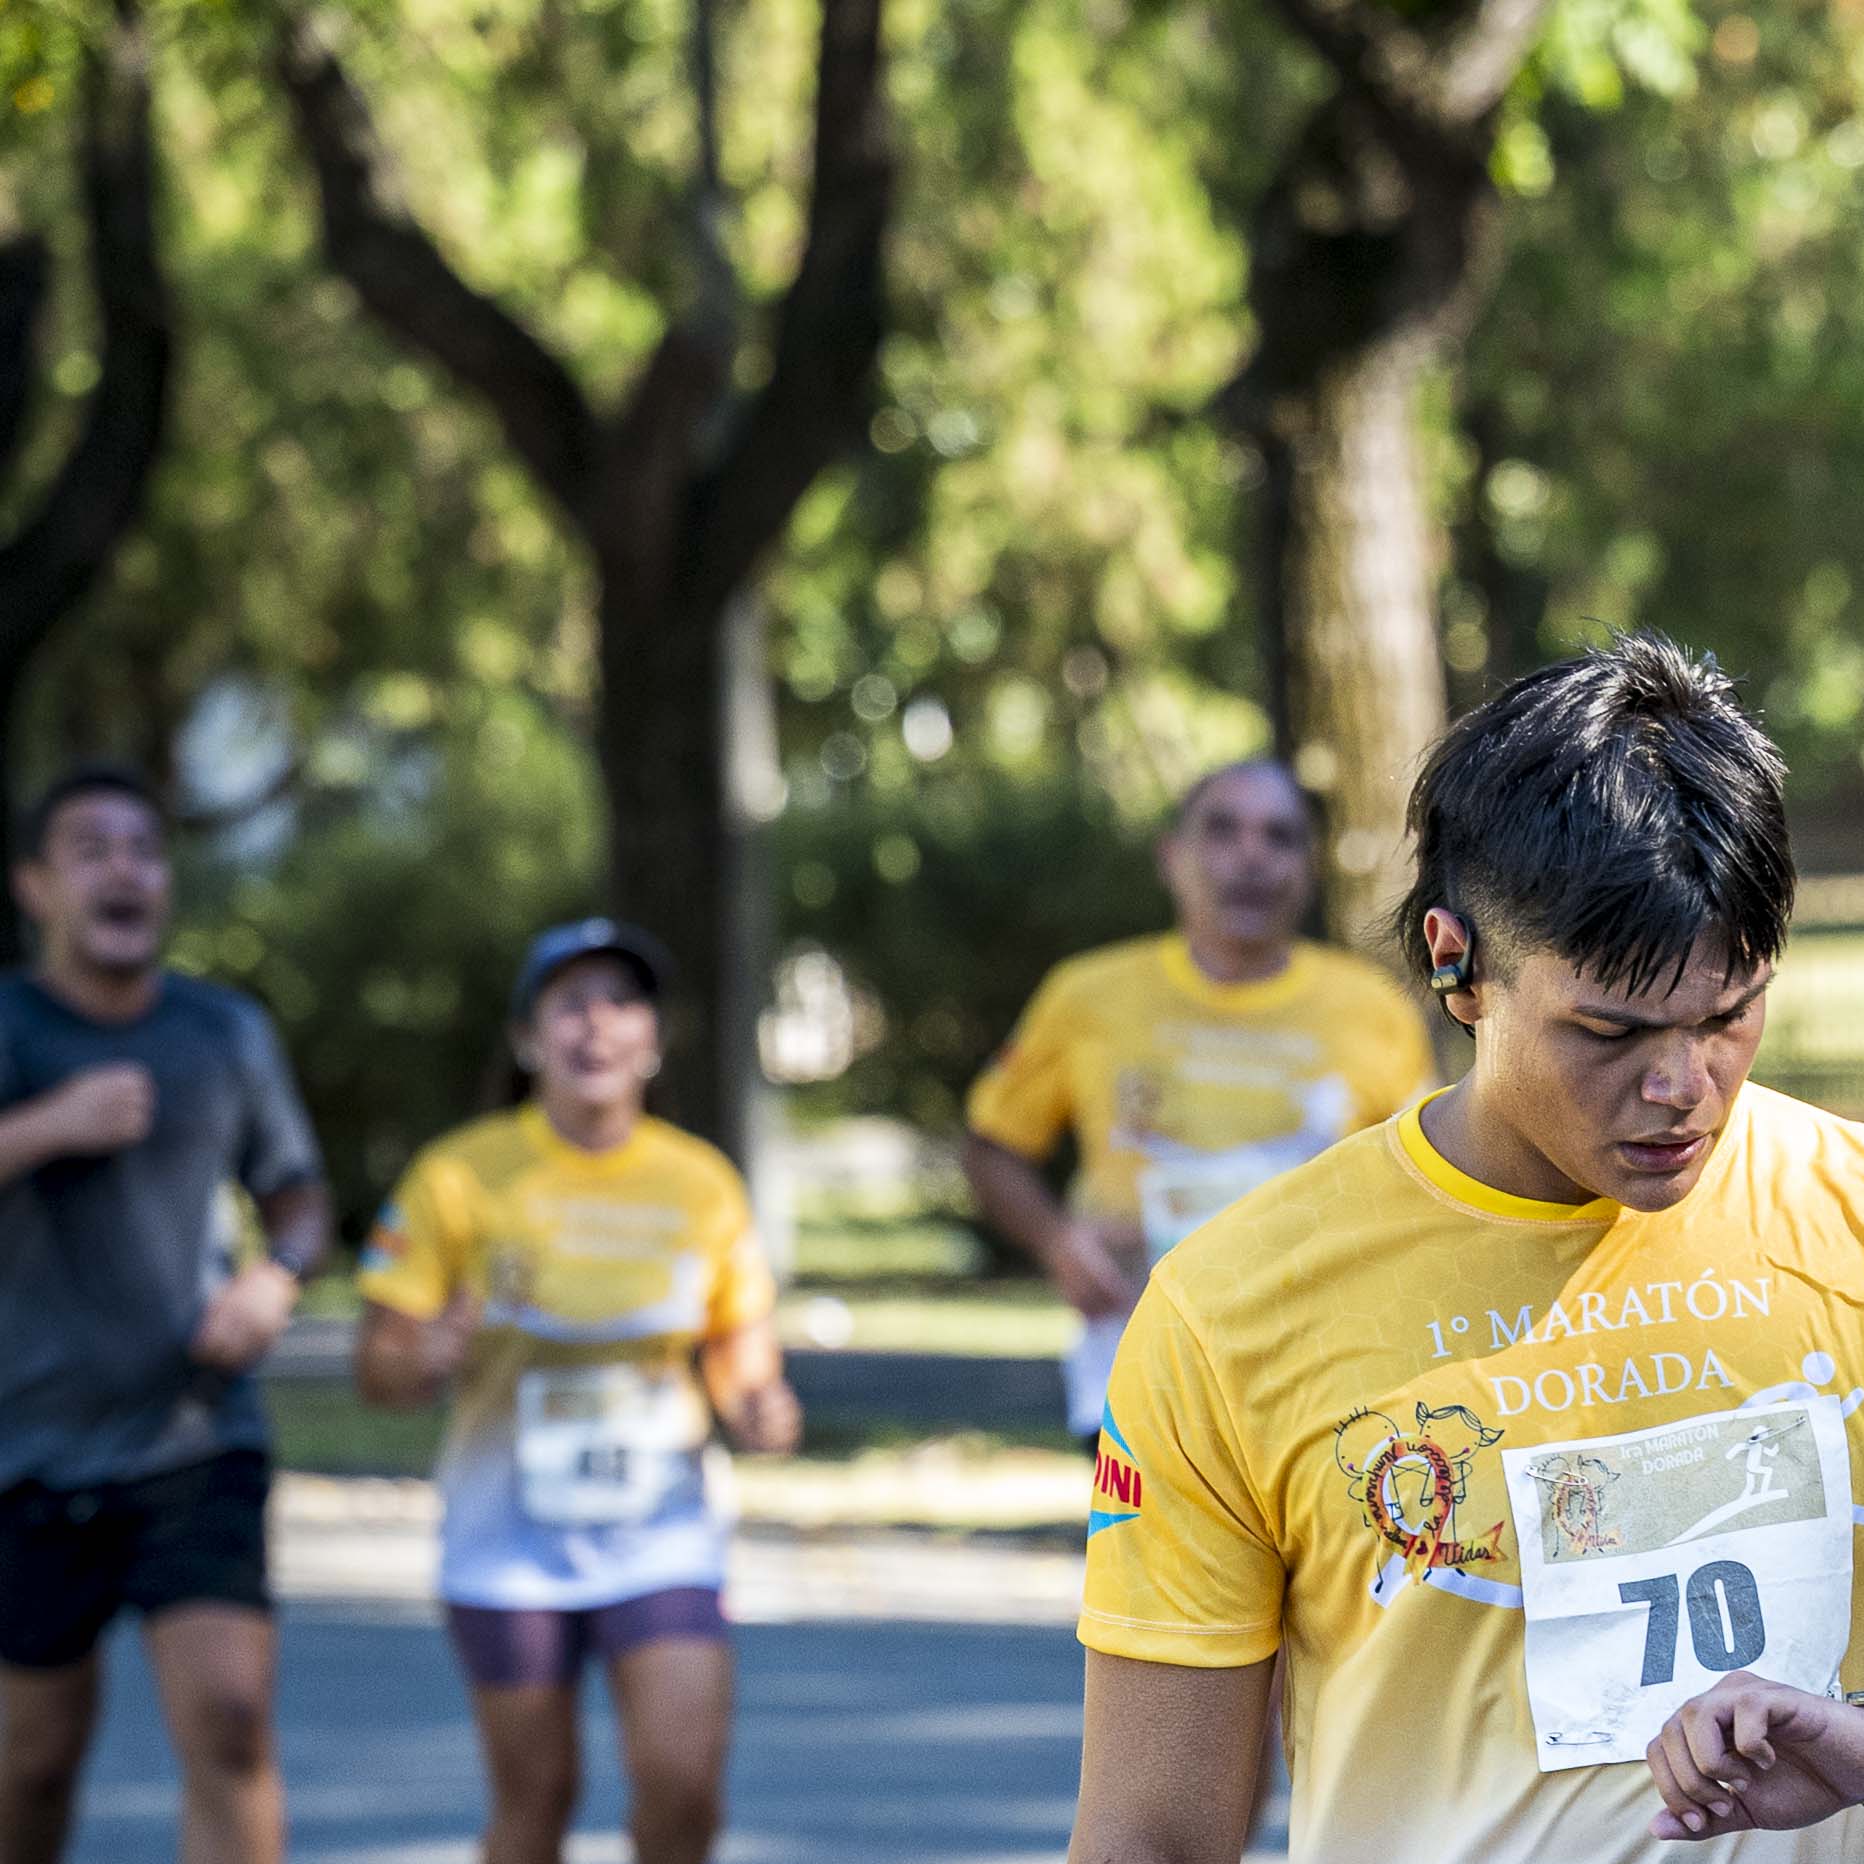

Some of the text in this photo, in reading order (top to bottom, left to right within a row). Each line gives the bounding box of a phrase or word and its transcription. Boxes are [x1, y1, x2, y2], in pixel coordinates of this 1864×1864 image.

[1485, 1268, 1771, 1349] MARATÓN
[1489, 1348, 1735, 1416] DORADA
[1094, 1449, 1142, 1508] INI
[1641, 1447, 1704, 1475] DORADA
[1438, 1539, 1494, 1566] Vidas
[1618, 1559, 1766, 1688] 70
